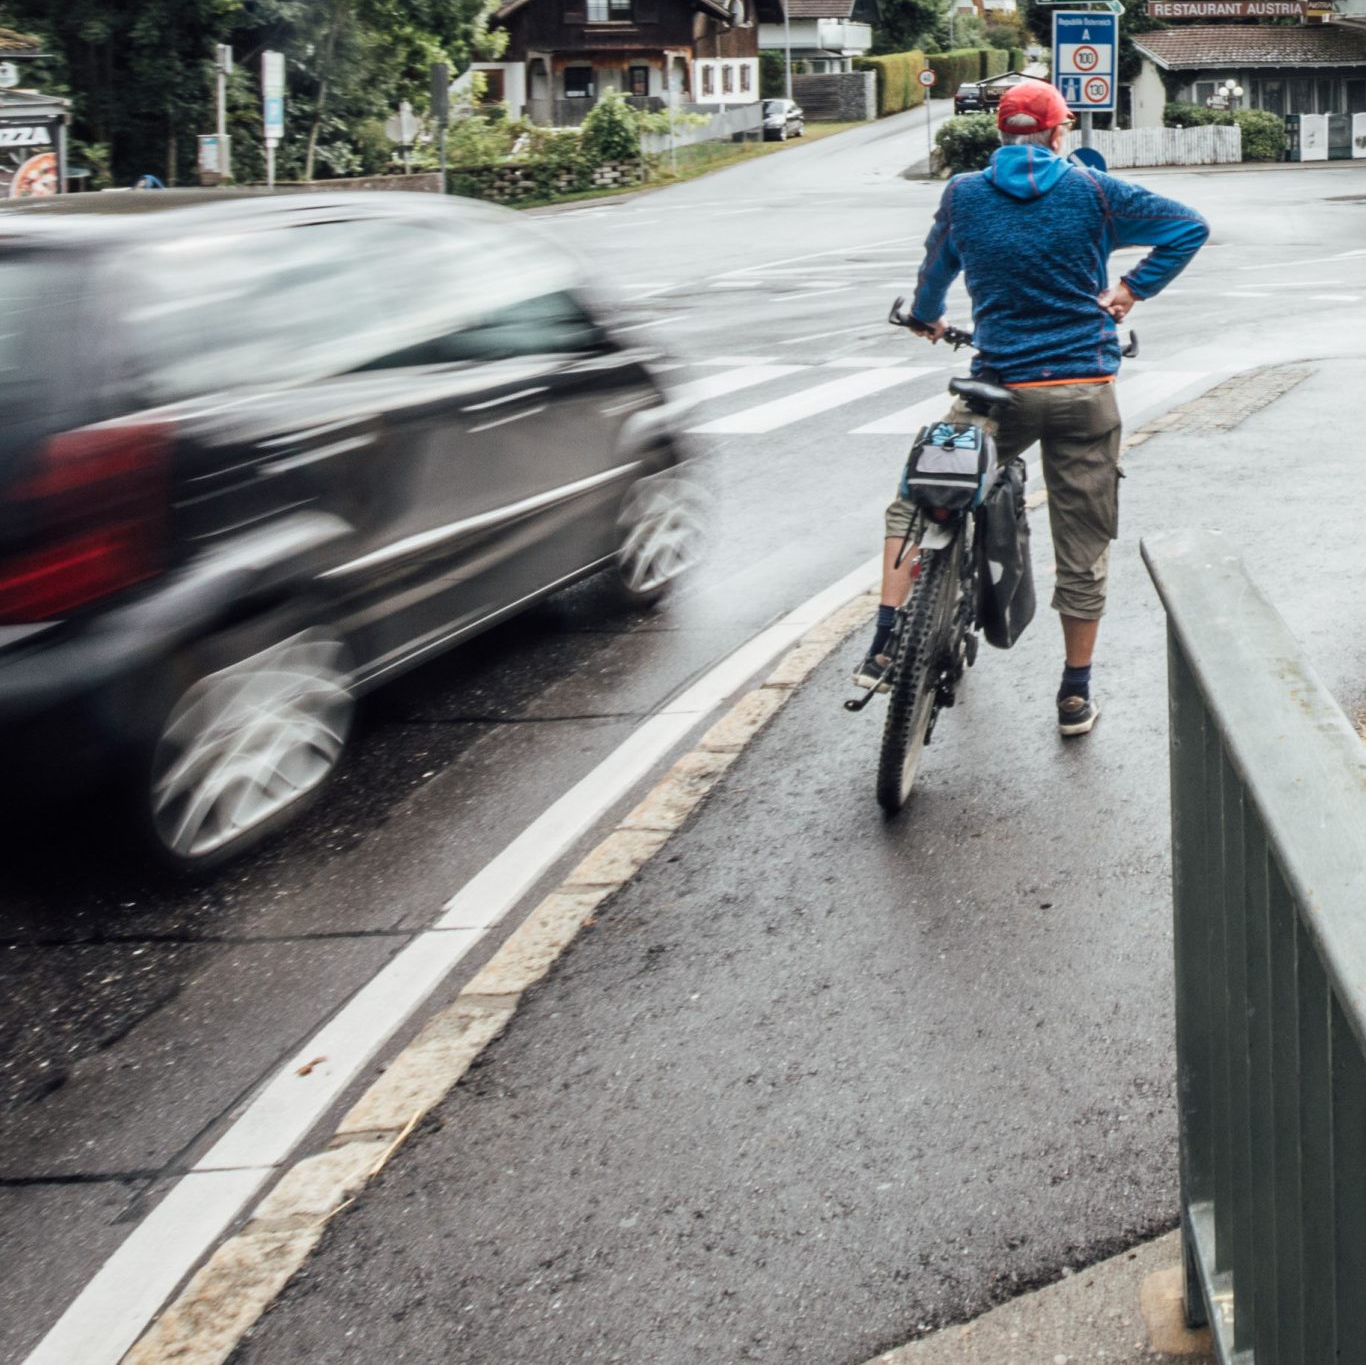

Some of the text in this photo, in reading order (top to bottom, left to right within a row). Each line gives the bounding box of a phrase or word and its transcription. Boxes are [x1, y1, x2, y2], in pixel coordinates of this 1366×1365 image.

[1154, 2, 1303, 16] RESTAURANT AUSTRIA
[1082, 28, 1091, 41] A
[1079, 53, 1094, 64] 100
[1090, 84, 1104, 96] 130
